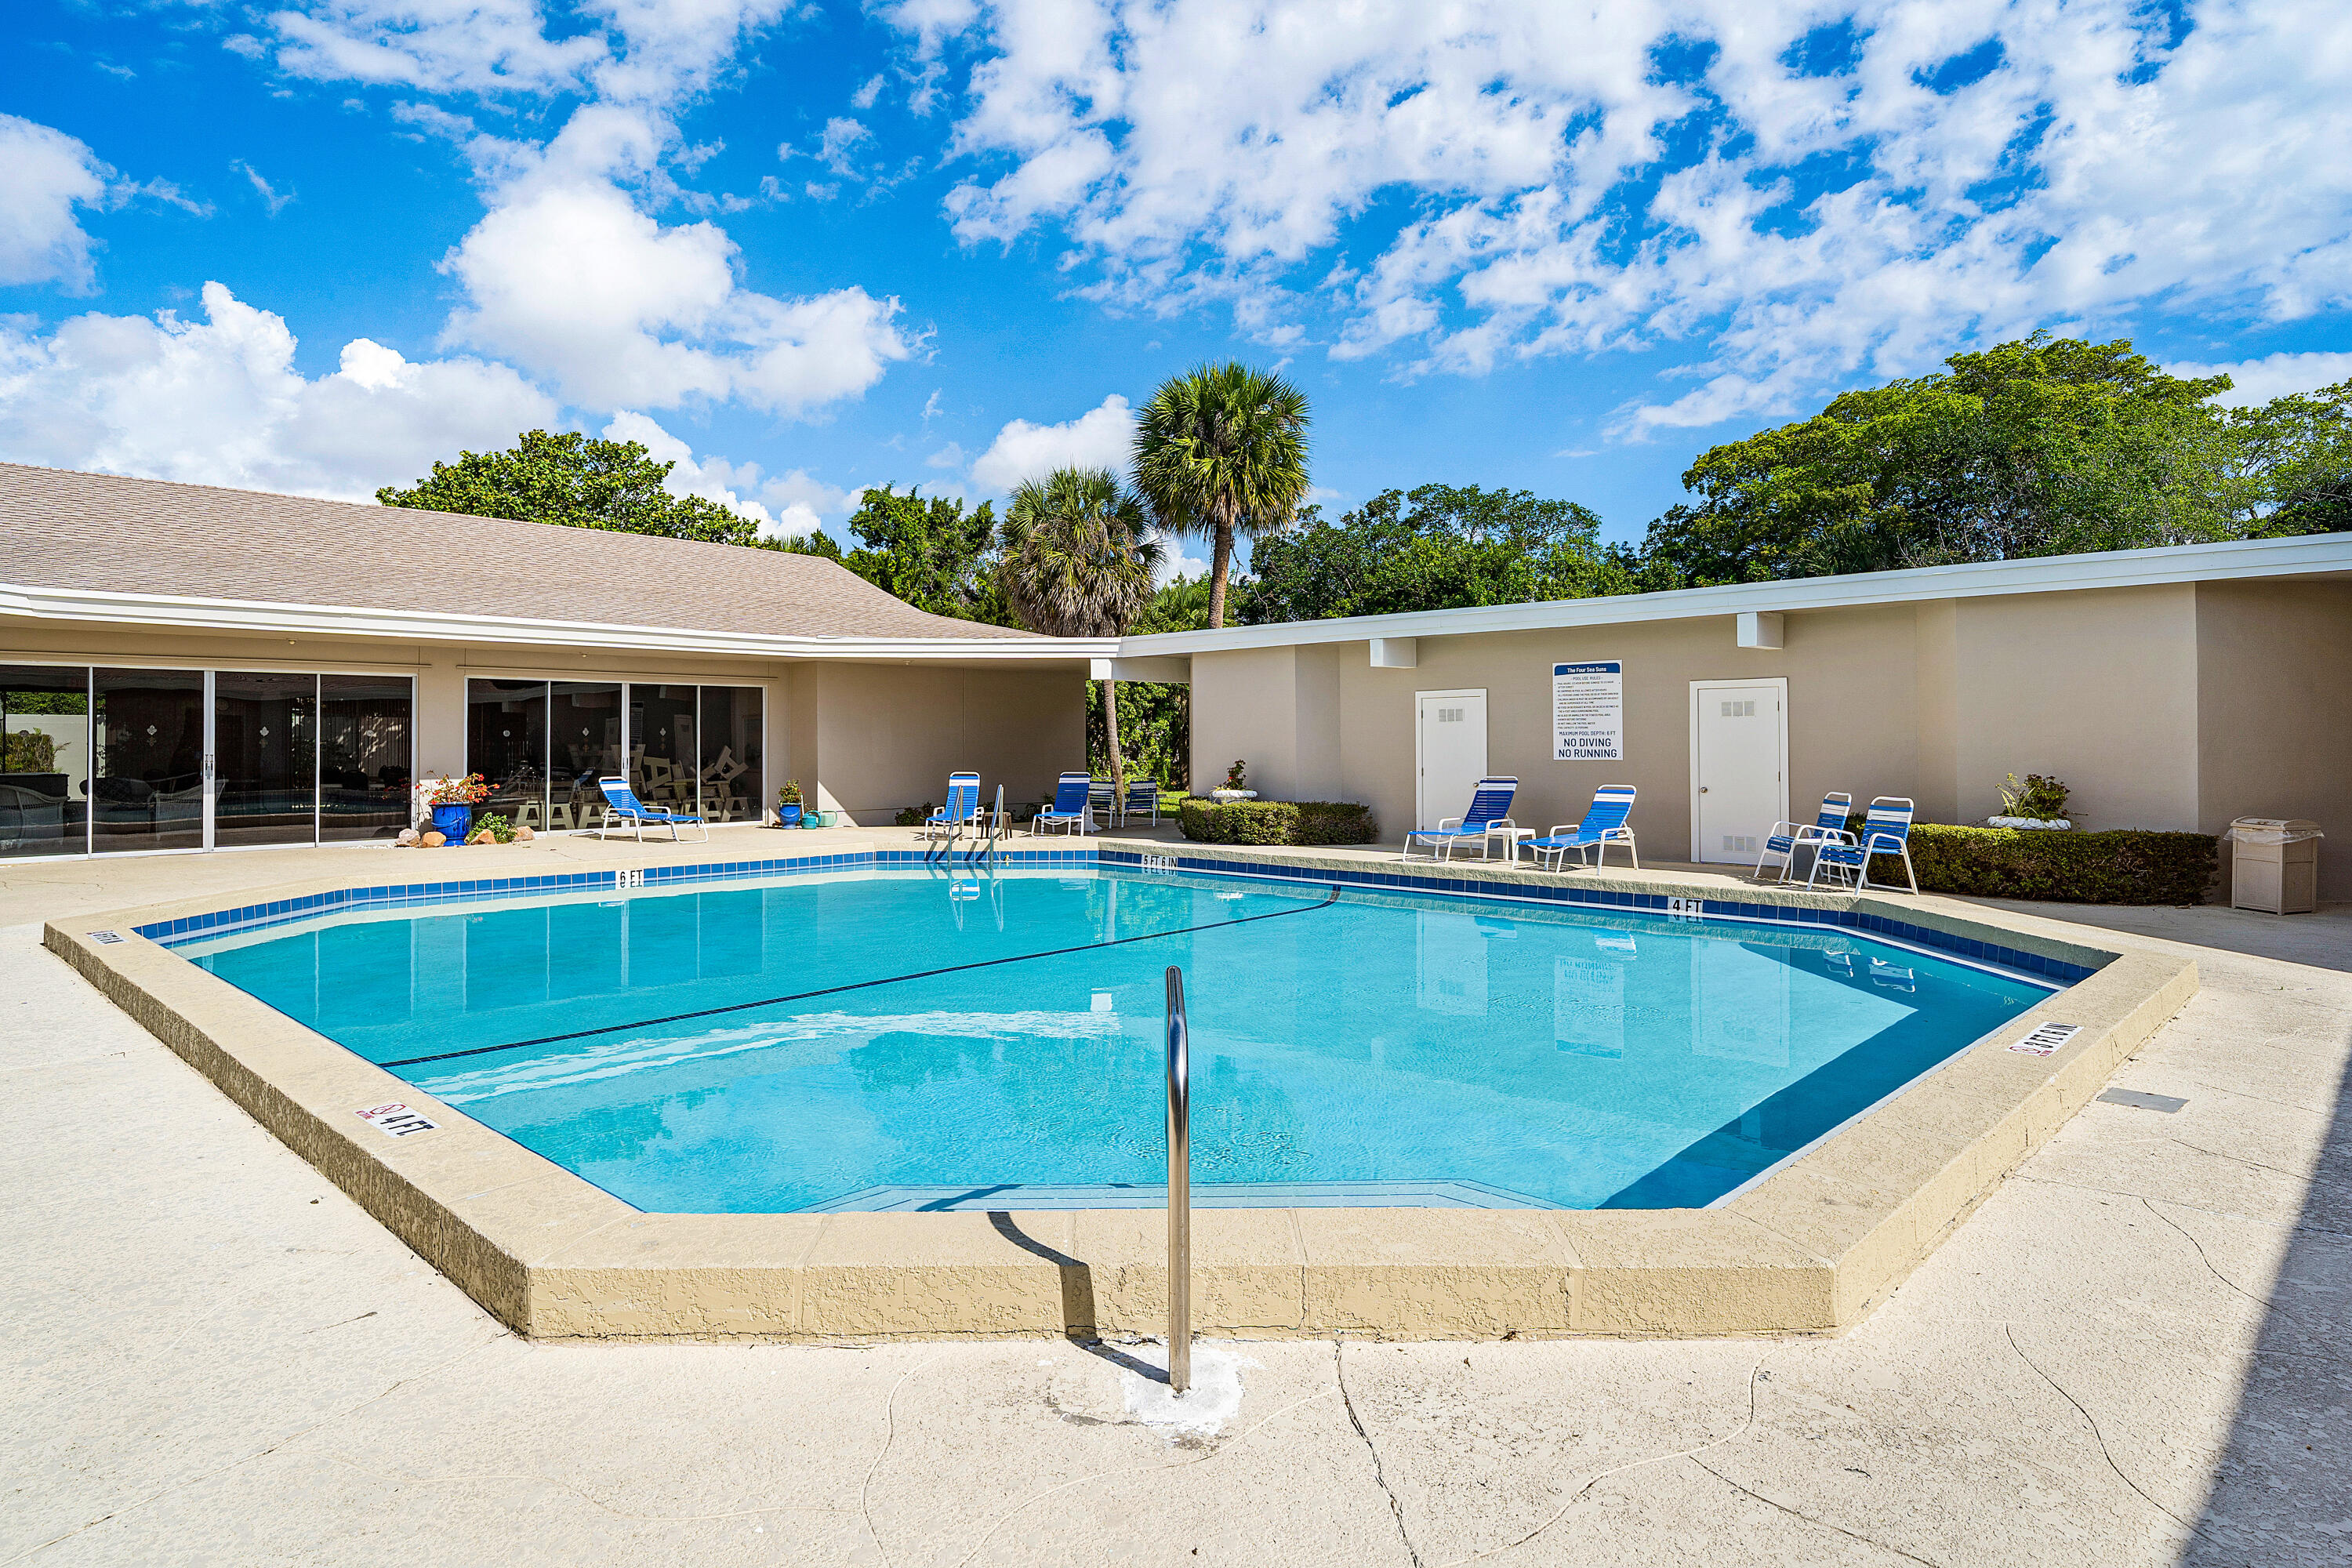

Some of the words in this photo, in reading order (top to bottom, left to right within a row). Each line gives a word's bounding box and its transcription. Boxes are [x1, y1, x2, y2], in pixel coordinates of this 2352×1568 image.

[1563, 738, 1577, 747] NO
[1579, 738, 1611, 747] DIVING
[1559, 749, 1571, 758] NO
[1573, 749, 1617, 758] RUNNING
[1144, 855, 1149, 865] 5
[1150, 855, 1160, 866] FT
[1161, 856, 1166, 866] 6
[1168, 857, 1178, 868] IN
[620, 871, 626, 881] 6
[630, 869, 643, 880] FT
[1672, 899, 1681, 911] 4
[1685, 898, 1702, 913] FT
[379, 1114, 416, 1125] 4
